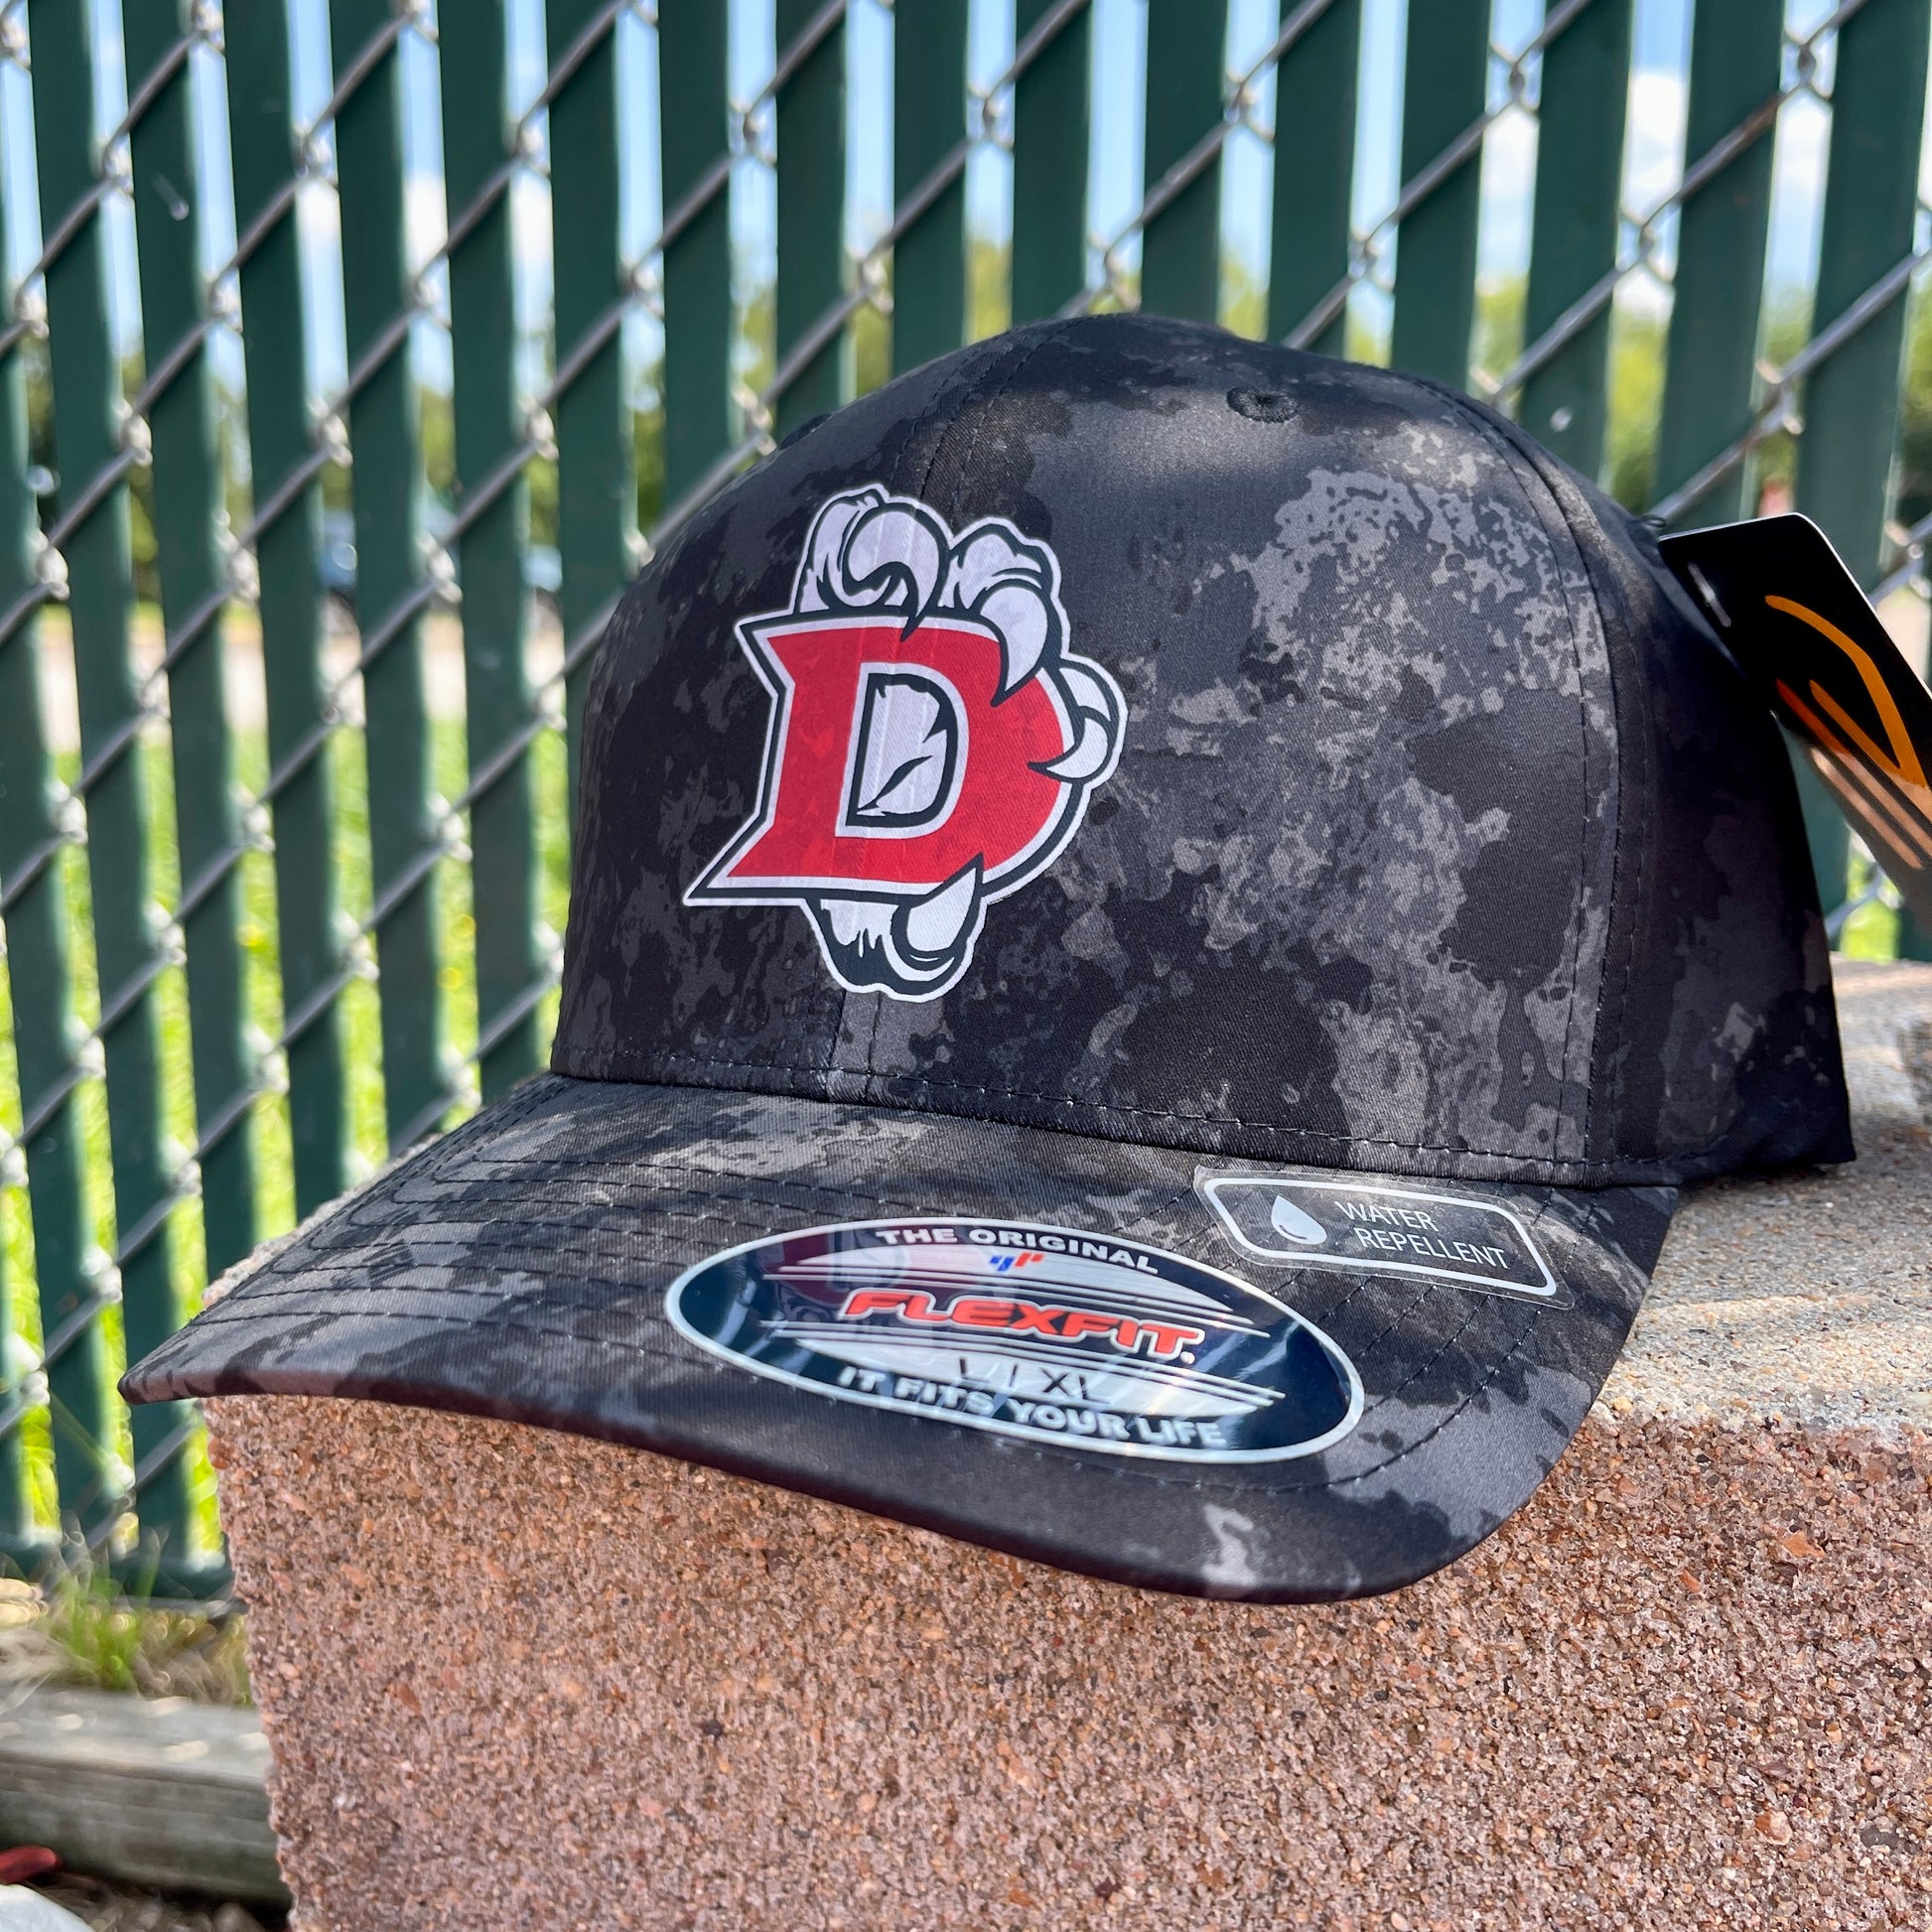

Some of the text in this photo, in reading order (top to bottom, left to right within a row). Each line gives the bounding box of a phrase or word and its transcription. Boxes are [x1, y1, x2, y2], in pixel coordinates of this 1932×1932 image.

[685, 612, 1086, 905] D
[1333, 1199, 1440, 1233] WATER
[875, 1227, 1160, 1276] THE ORIGINAL
[1352, 1226, 1510, 1271] REPELLENT
[837, 1364, 1228, 1449] IT FITS YOUR LIFE
